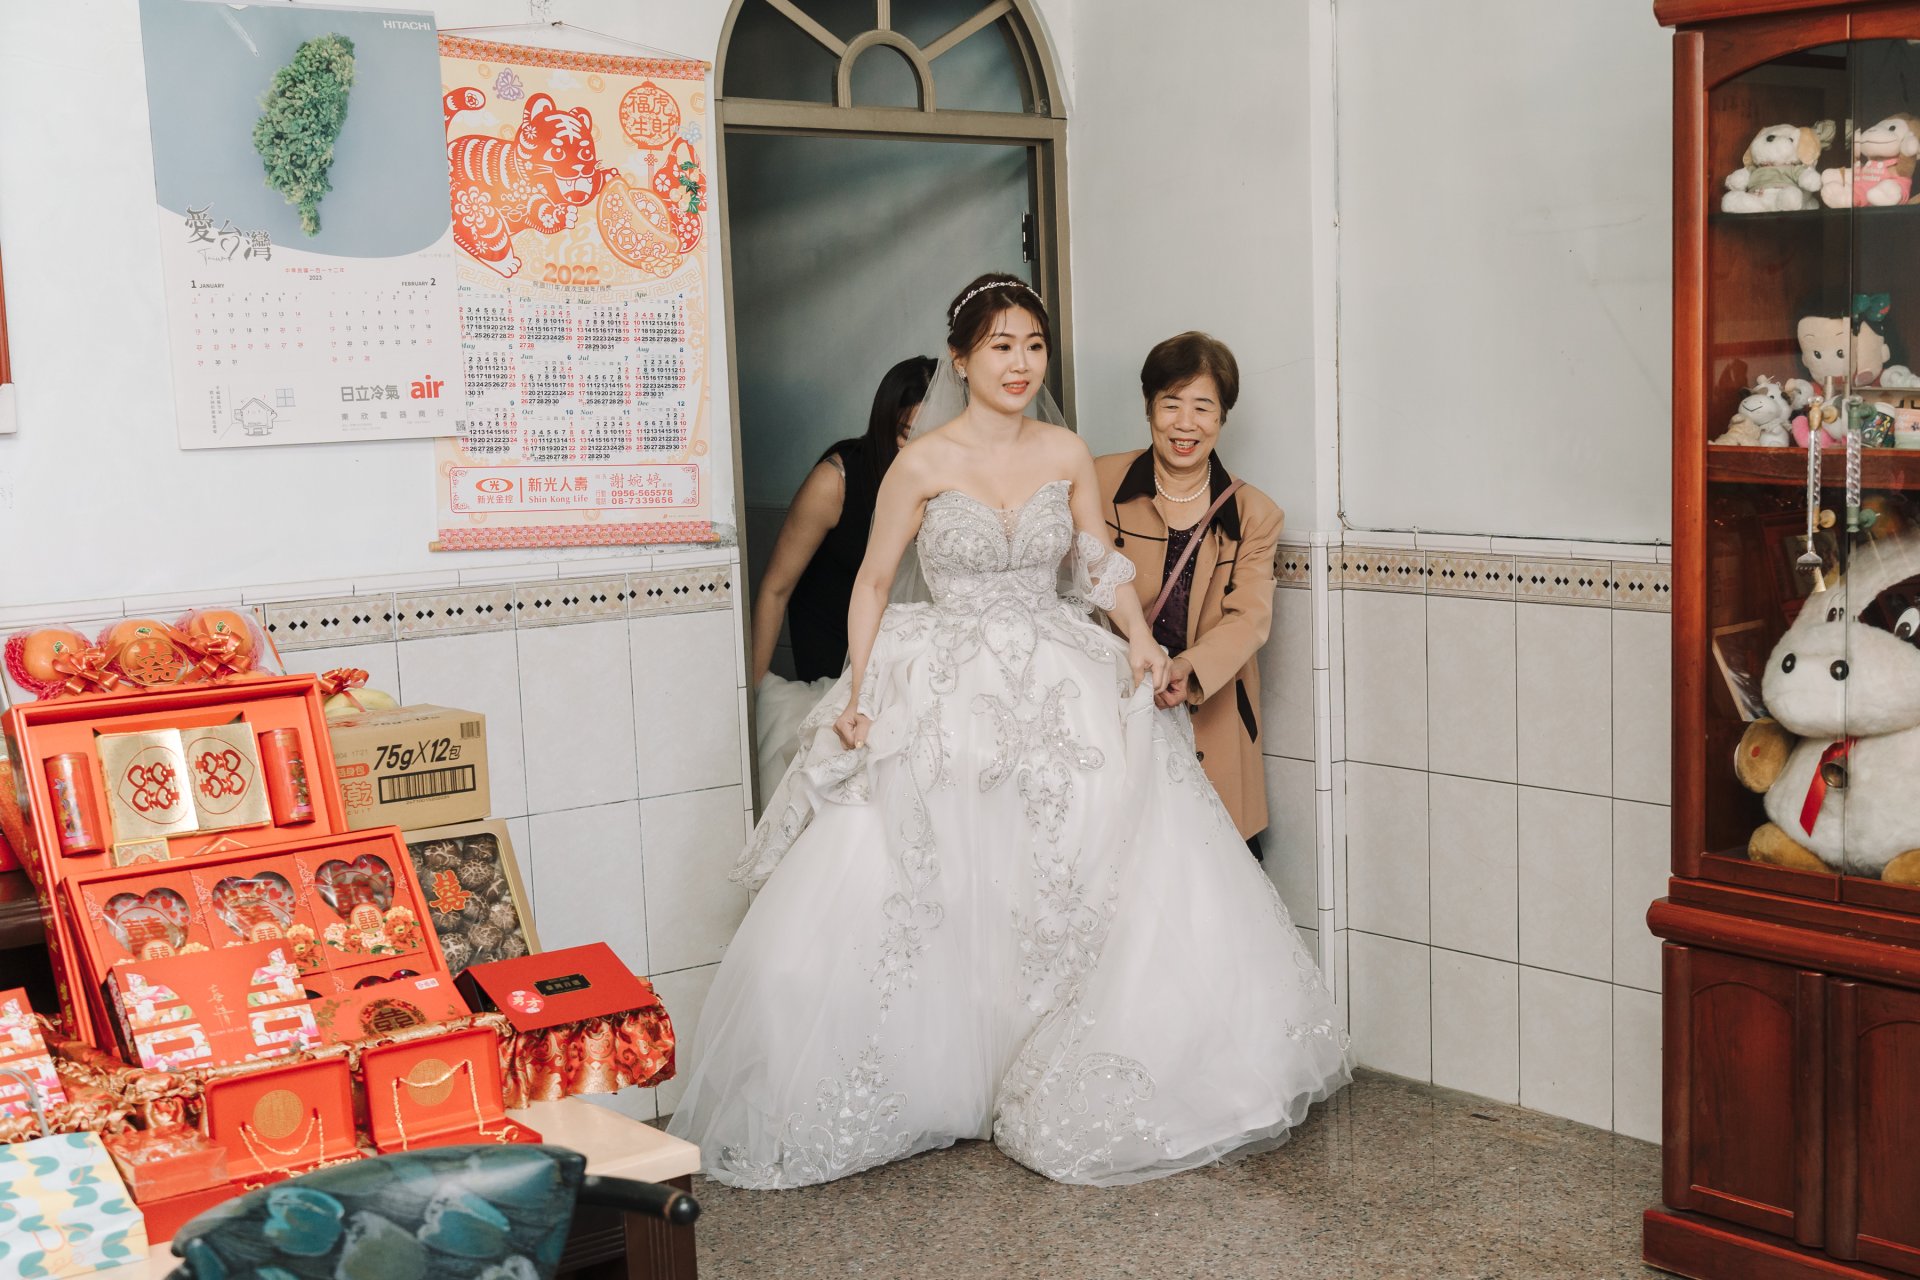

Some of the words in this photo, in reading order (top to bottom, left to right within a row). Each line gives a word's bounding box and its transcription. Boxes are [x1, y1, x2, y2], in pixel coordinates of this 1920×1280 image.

[383, 20, 431, 31] HITACHI
[184, 203, 272, 262] 愛台灣
[544, 263, 600, 285] 2022
[190, 280, 197, 289] 1
[430, 278, 437, 289] 2
[341, 385, 399, 402] 日立冷氣
[411, 375, 444, 399] air
[490, 480, 500, 491] 光
[528, 476, 588, 492] 新光人壽
[610, 473, 661, 488] 謝婉婷
[477, 494, 514, 504] 新光金控
[550, 496, 570, 504] Kong
[512, 994, 541, 1010] 男方
